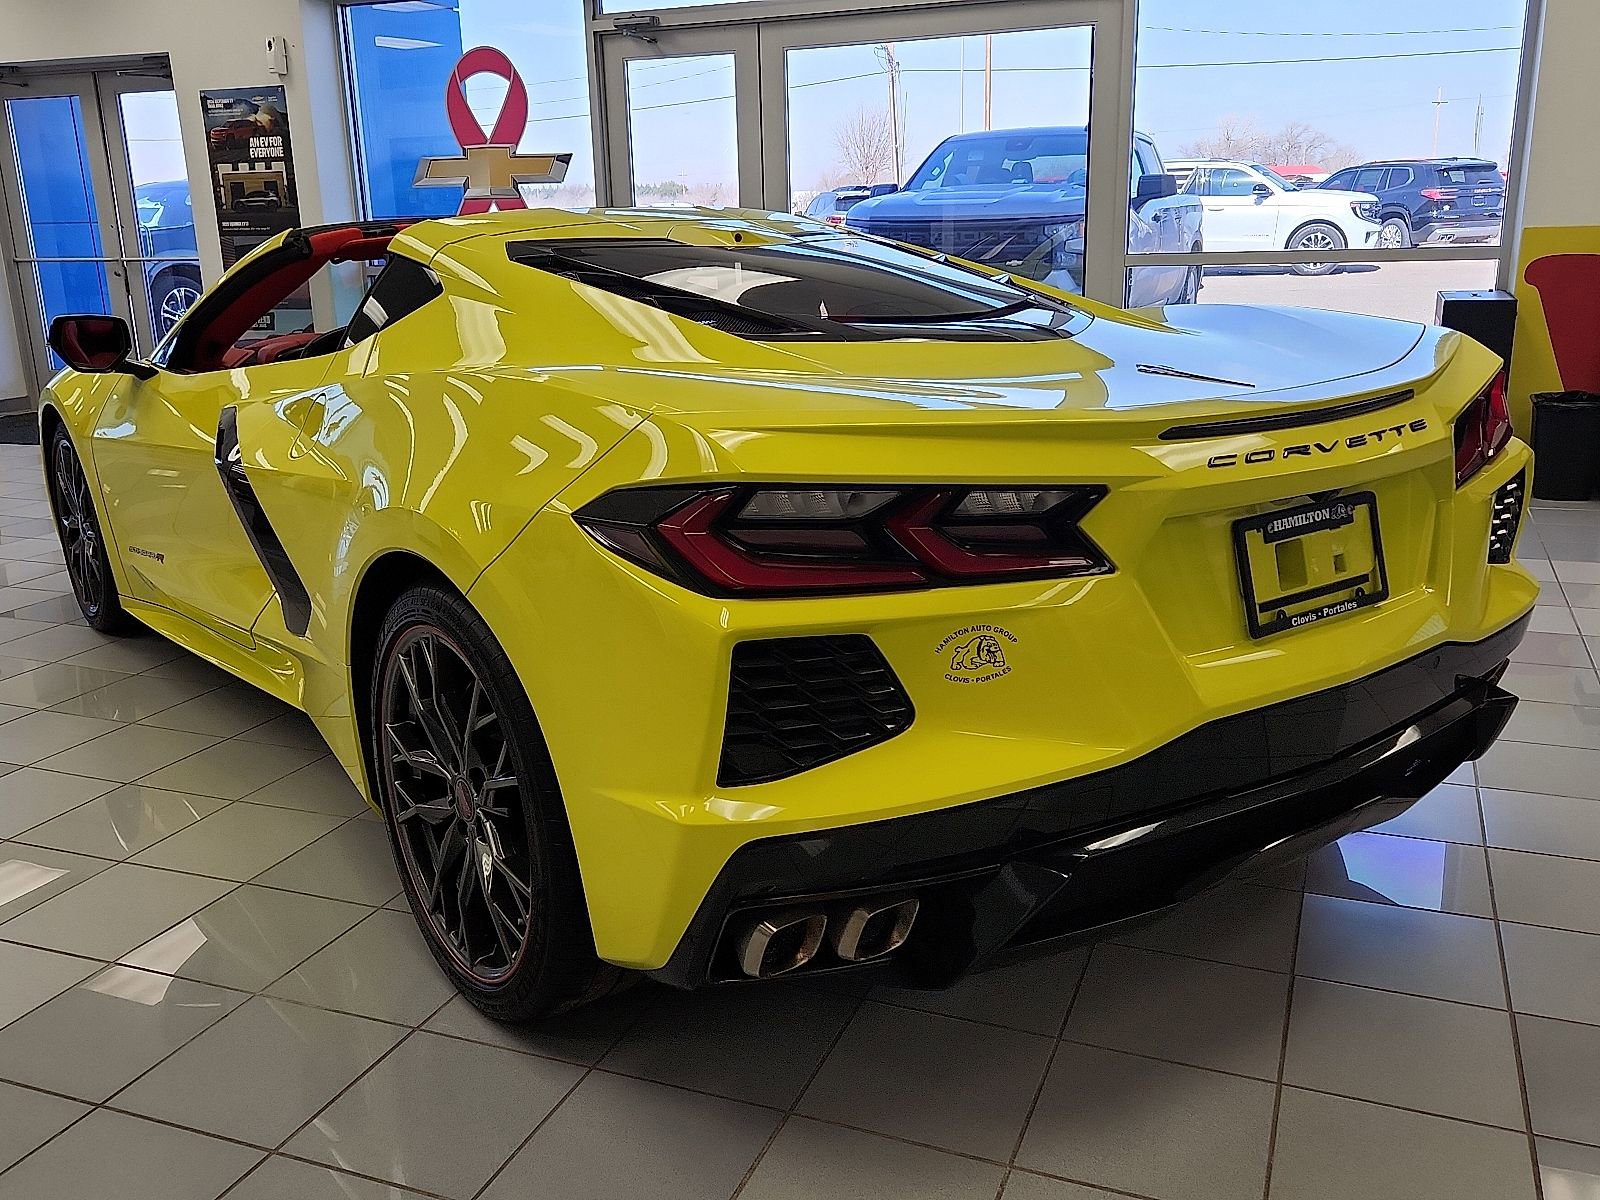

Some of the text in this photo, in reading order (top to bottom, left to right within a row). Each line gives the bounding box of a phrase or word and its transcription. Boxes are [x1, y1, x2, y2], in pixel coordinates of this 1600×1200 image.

[249, 136, 282, 148] AN EV FOR
[249, 147, 284, 158] EVERYONE
[1207, 418, 1428, 469] CORVETTE
[1273, 508, 1330, 532] HAMILTON
[1291, 601, 1358, 627] Clovis Portales
[934, 624, 1018, 654] HAMILTON AUTO GROUP
[944, 665, 1012, 684] CLOVIS PORTALES
